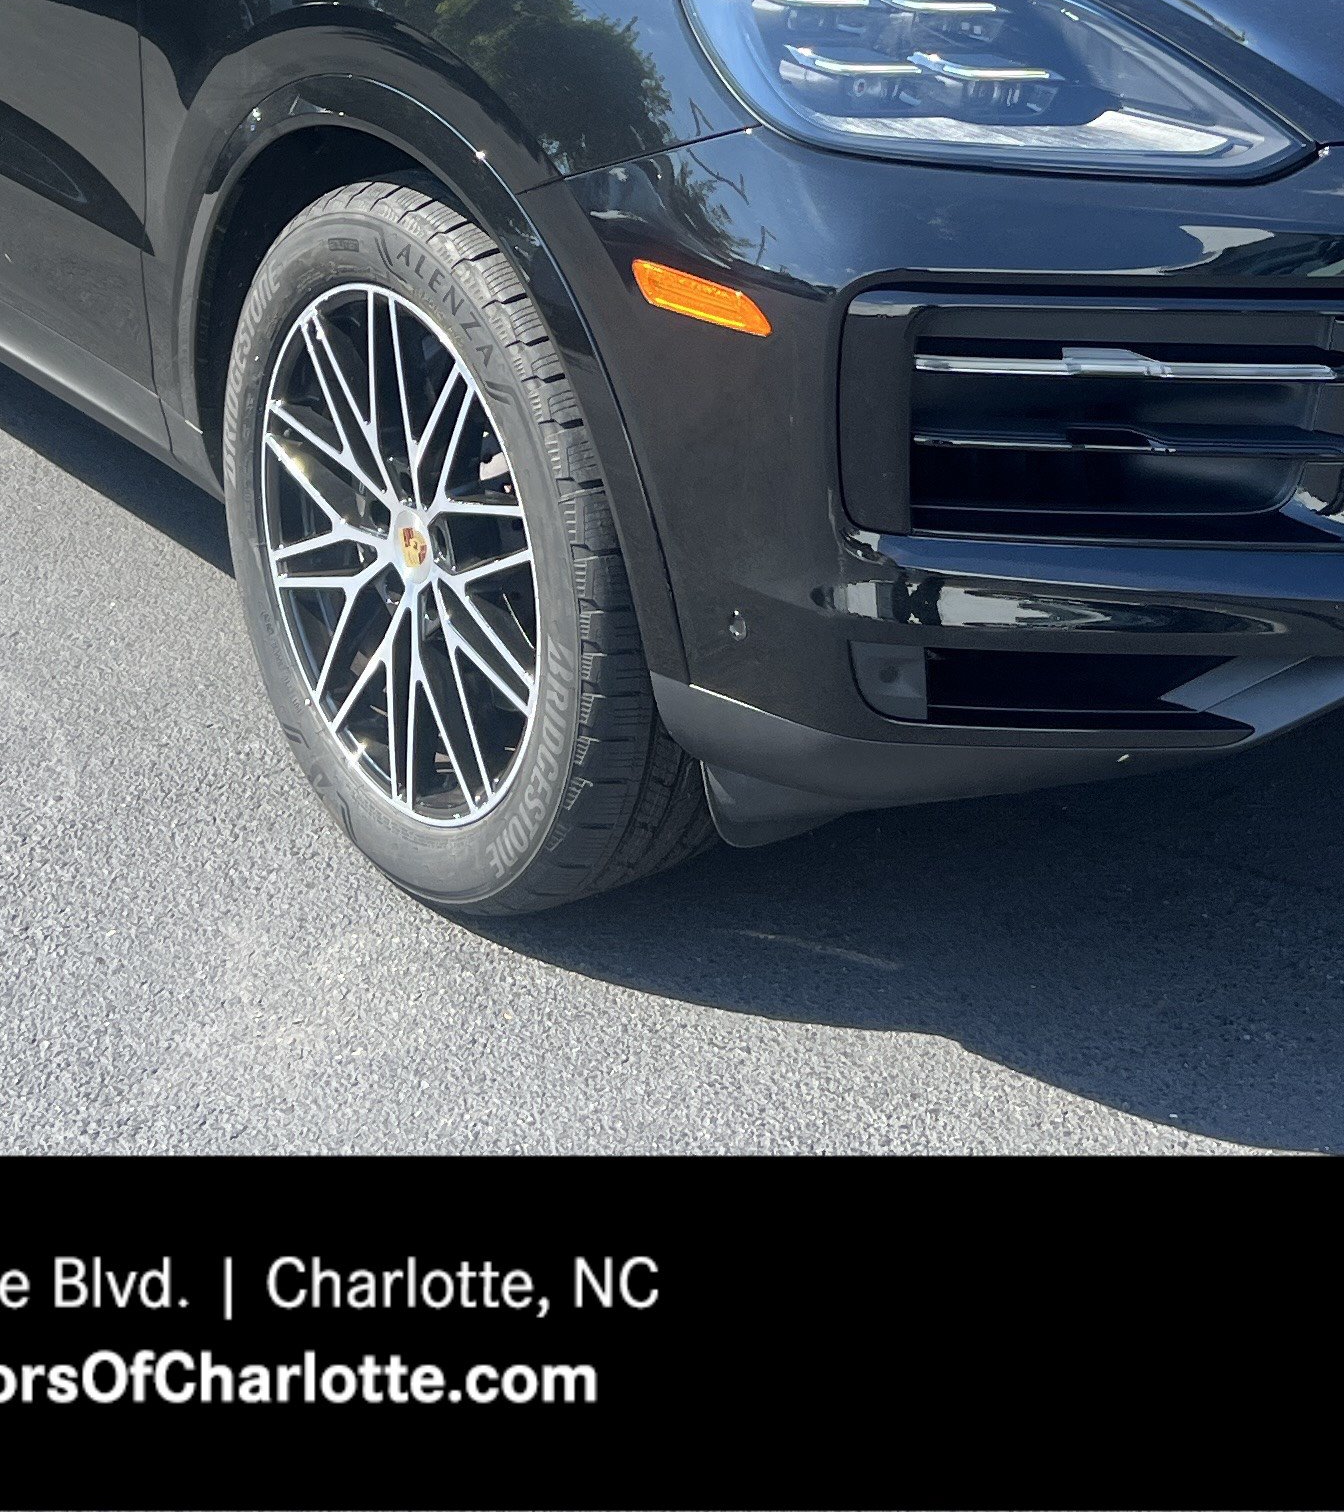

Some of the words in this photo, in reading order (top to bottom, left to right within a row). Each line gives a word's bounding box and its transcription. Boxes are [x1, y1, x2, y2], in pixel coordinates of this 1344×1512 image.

[223, 260, 282, 489] BRIDGESTONE
[396, 243, 494, 369] ALENZA
[485, 635, 575, 878] BRIDGESTONE
